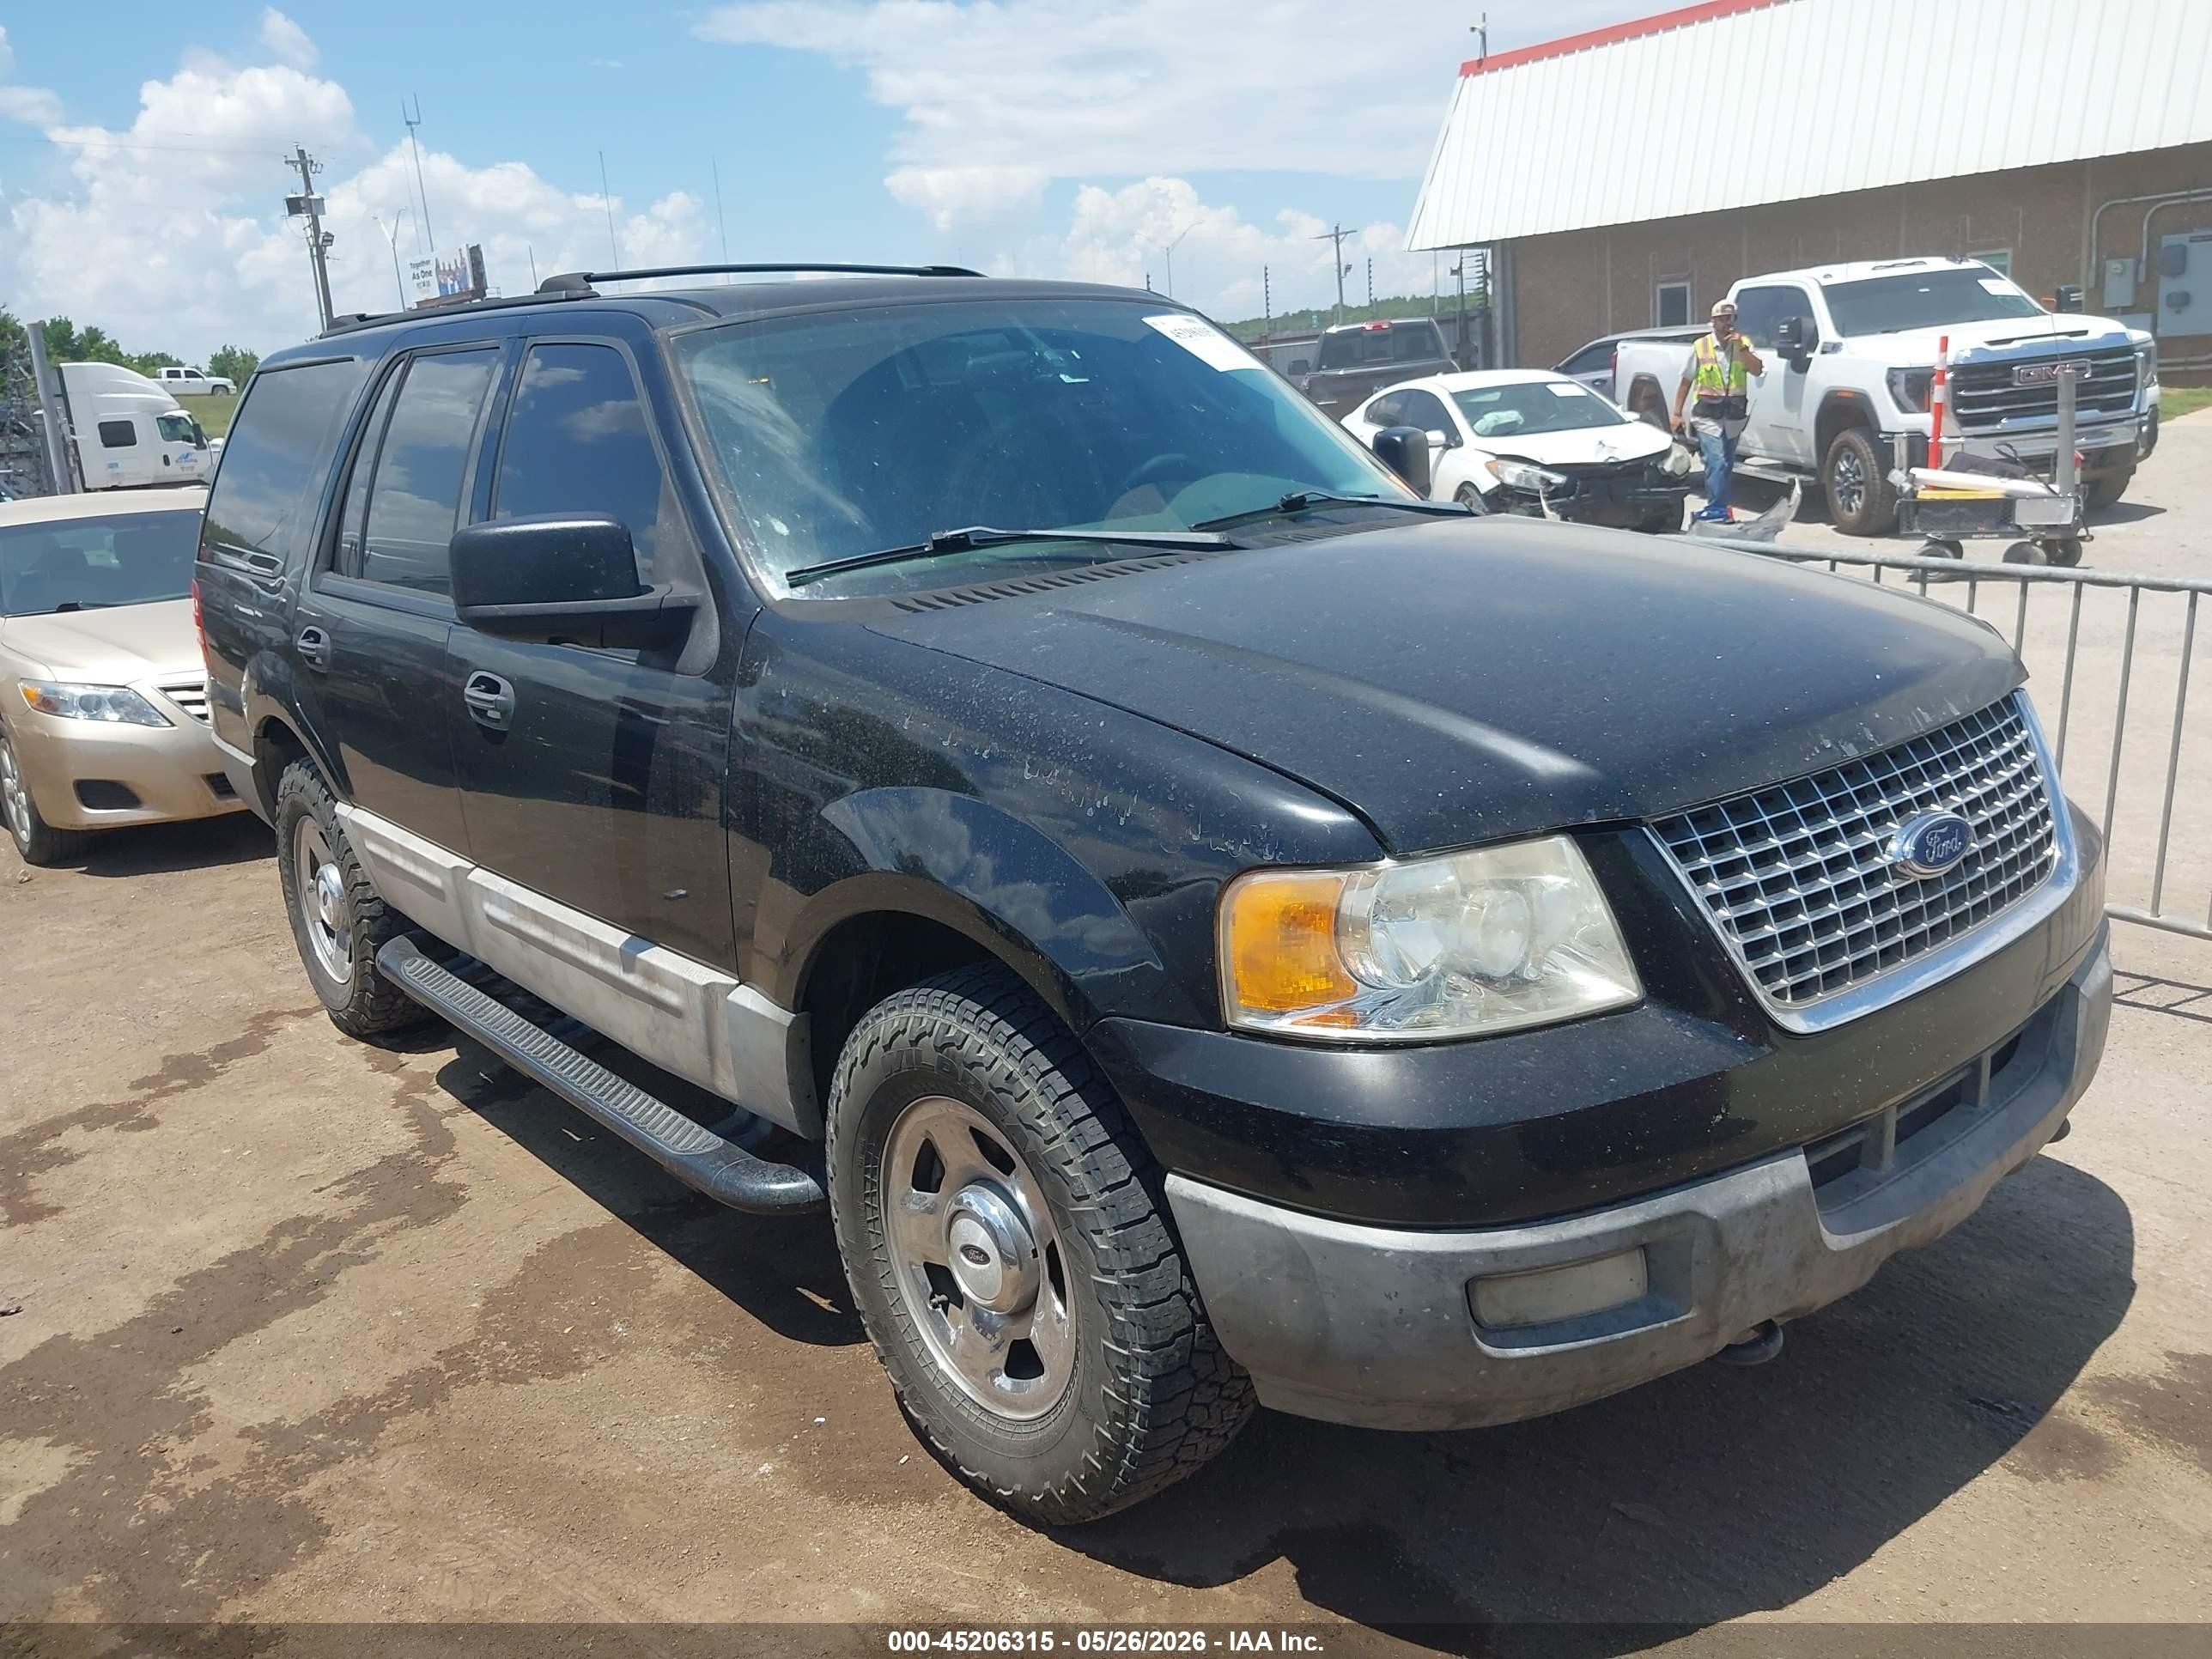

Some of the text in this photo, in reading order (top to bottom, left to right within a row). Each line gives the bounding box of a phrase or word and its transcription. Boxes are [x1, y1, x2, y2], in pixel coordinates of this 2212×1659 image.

[412, 269, 433, 281] As One
[1926, 826, 1962, 863] Ford
[969, 1249, 985, 1261] Ford
